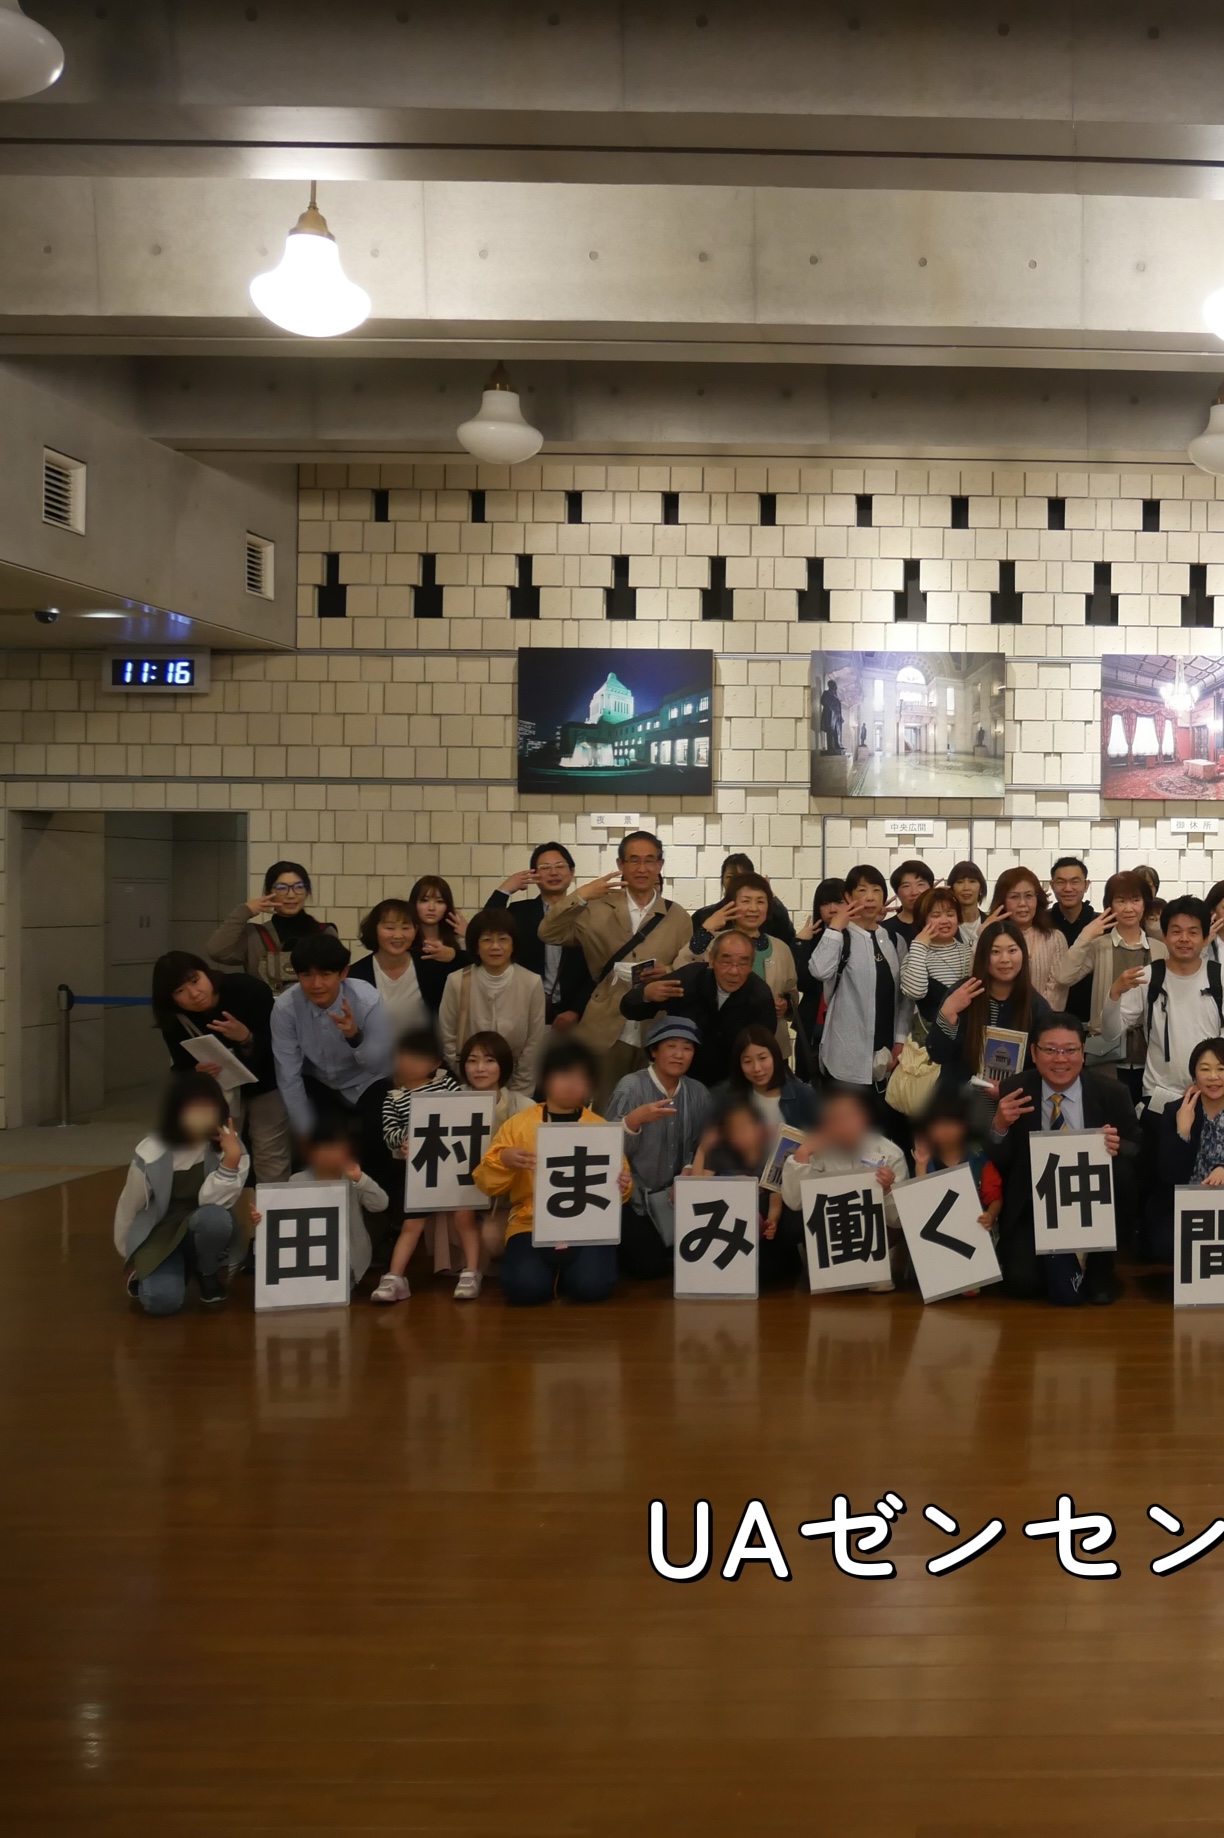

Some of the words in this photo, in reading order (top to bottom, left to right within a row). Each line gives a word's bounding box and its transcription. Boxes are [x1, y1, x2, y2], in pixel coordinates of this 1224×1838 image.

[124, 661, 190, 684] 11:16
[890, 823, 926, 832] 中央広間
[1176, 820, 1212, 829] 御休所
[412, 1112, 490, 1188] 村
[546, 1146, 611, 1218] ま
[919, 1189, 976, 1260] く
[1035, 1151, 1112, 1230] 仲
[266, 1207, 339, 1285] 田
[679, 1199, 755, 1270] み
[806, 1188, 886, 1269] 働
